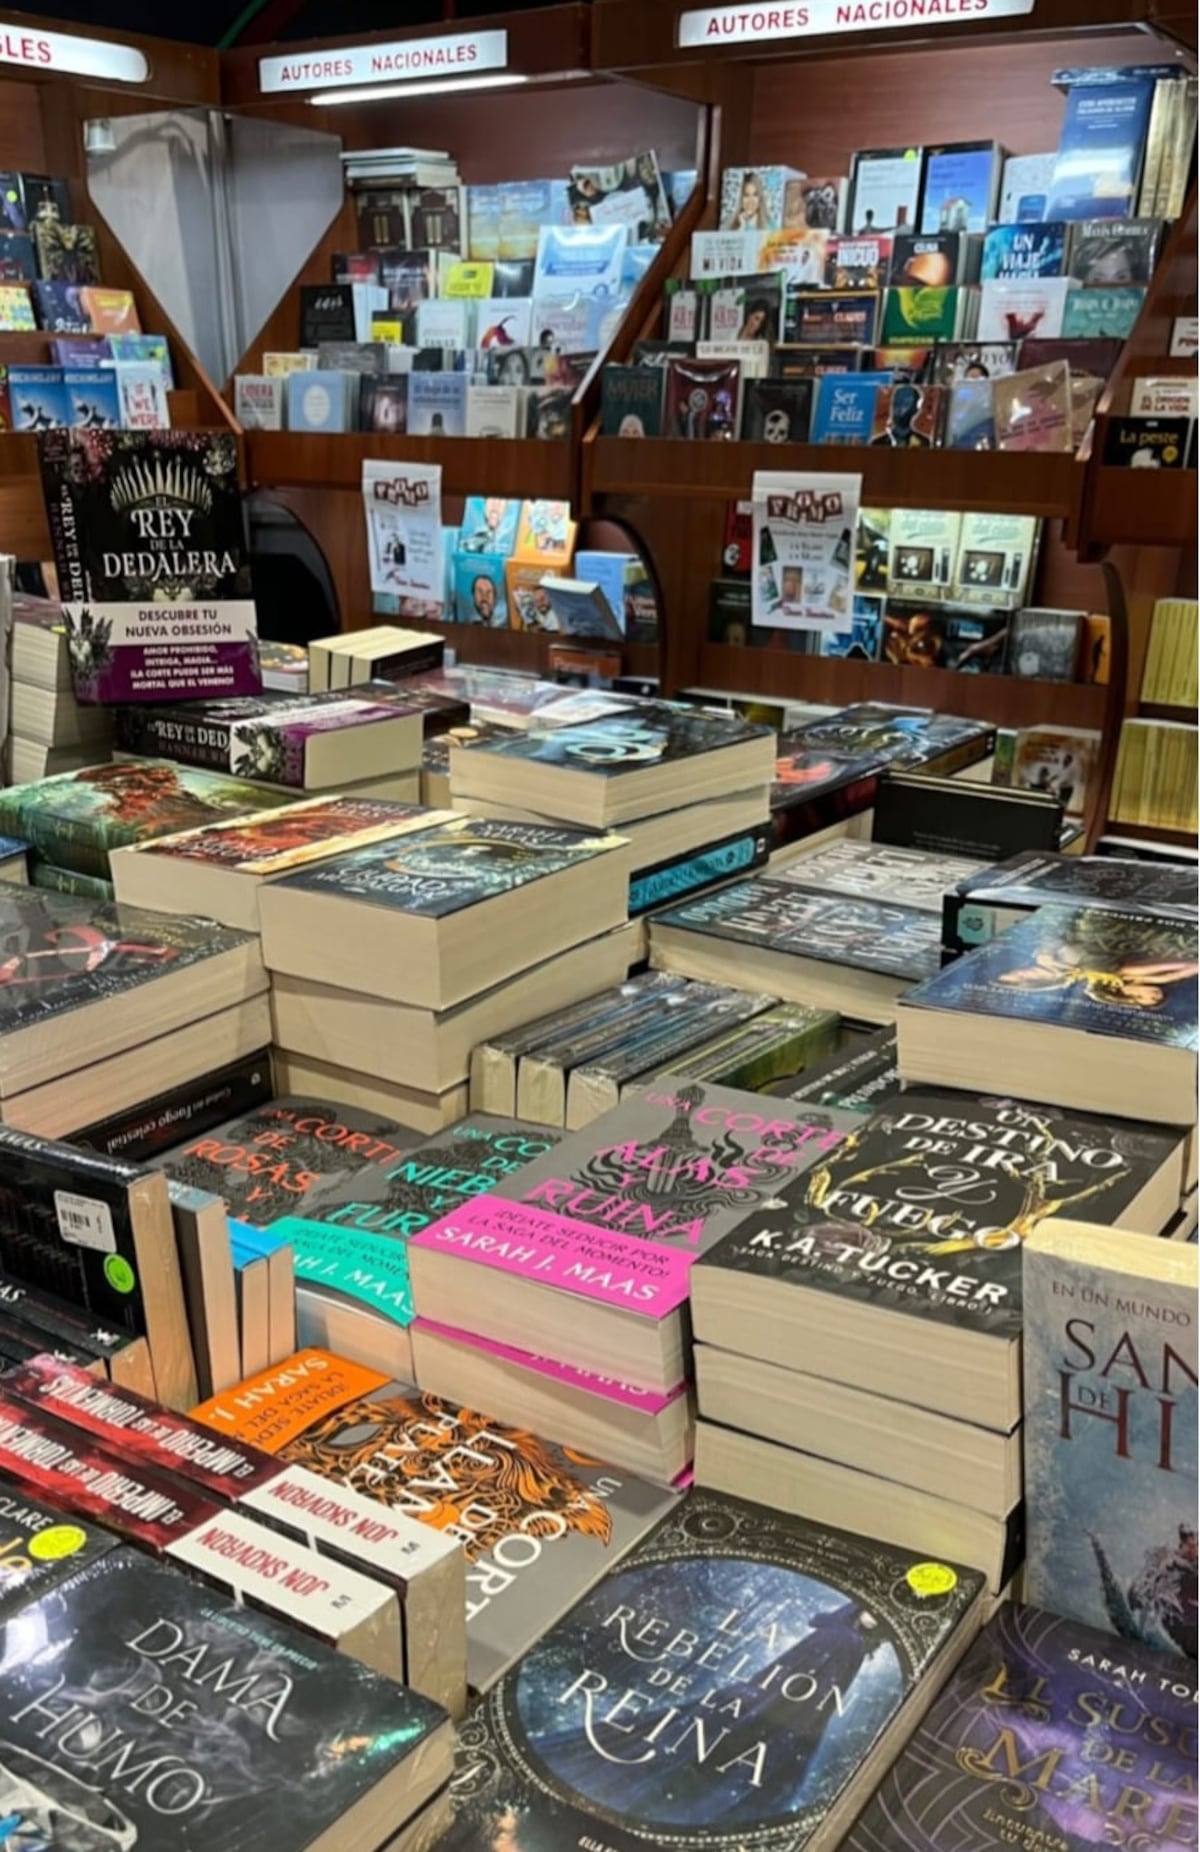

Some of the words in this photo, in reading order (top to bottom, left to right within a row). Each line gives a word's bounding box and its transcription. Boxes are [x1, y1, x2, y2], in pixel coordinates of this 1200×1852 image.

[706, 8, 810, 36] AUTORES
[836, 0, 989, 24] NACIONALES
[0, 33, 52, 63] LES
[281, 59, 354, 82] AUTORES
[371, 44, 478, 73] NACIONALES
[1002, 252, 1041, 270] VIAJE
[830, 405, 864, 423] Feliz
[833, 389, 858, 405] Ser
[1120, 429, 1136, 444] La
[1139, 431, 1179, 446] peste
[131, 509, 194, 538] REY
[150, 539, 167, 551] DE
[170, 539, 185, 551] LA
[102, 550, 237, 582] DEDALERA
[126, 626, 168, 638] NUEVA
[172, 623, 232, 637] OBSESIÓN
[138, 610, 199, 622] DESCUBRE
[203, 609, 217, 621] TU
[132, 680, 167, 690] MORTAL
[168, 679, 187, 689] QUE
[189, 678, 198, 688] EL
[146, 668, 171, 679] CORTE
[173, 667, 199, 678] PUEDE
[201, 666, 216, 676] SER
[155, 720, 184, 741] REY
[106, 1120, 156, 1154] celestial
[253, 1130, 296, 1151] DE
[452, 1125, 492, 1141] UNA
[995, 1108, 1055, 1136] UN
[890, 1112, 1127, 1171] DESTINO
[903, 1136, 955, 1156] DE
[963, 1143, 1062, 1184] IRA
[181, 1139, 321, 1192] ROSAS
[594, 1139, 758, 1191] ALAS
[524, 1178, 709, 1246] RUINA
[820, 1189, 1021, 1252] FUEGO
[468, 1215, 492, 1230] LA
[492, 1221, 537, 1242] SAGA
[540, 1234, 572, 1251] DEL
[557, 1226, 626, 1253] SEDUCIR
[631, 1246, 670, 1265] POR
[436, 1227, 531, 1264] SARAH
[563, 1262, 659, 1301] MAAS
[834, 1242, 1009, 1305] TUCKER
[1052, 1280, 1076, 1298] EN
[1081, 1288, 1109, 1307] UN
[1116, 1299, 1192, 1328] MUNDO
[39, 1375, 144, 1429] TORMENTAS
[233, 1356, 329, 1411] SARAH
[1077, 1385, 1113, 1409] DE
[159, 1429, 246, 1475] IMPERIO
[343, 1410, 461, 1496] PLATE
[235, 1463, 255, 1480] EL
[86, 1471, 177, 1522] IMPERIO
[268, 1475, 357, 1530] SKOVRON
[567, 1476, 623, 1512] UNA
[164, 1507, 184, 1526] EL
[352, 1517, 398, 1545] JON
[196, 1527, 287, 1580] SKOVRON
[281, 1568, 331, 1598] JON
[716, 1607, 782, 1651] LA
[602, 1603, 851, 1718] REBELIÓN
[1066, 1648, 1147, 1684] SARAH
[125, 1616, 295, 1744] DAMA
[647, 1667, 692, 1697] DE
[700, 1683, 744, 1719] LA
[129, 1683, 199, 1730] DE
[9, 1673, 207, 1816] HUMO
[559, 1668, 769, 1789] REINA
[1081, 1737, 1138, 1774] DE
[1146, 1761, 1198, 1792] LA
